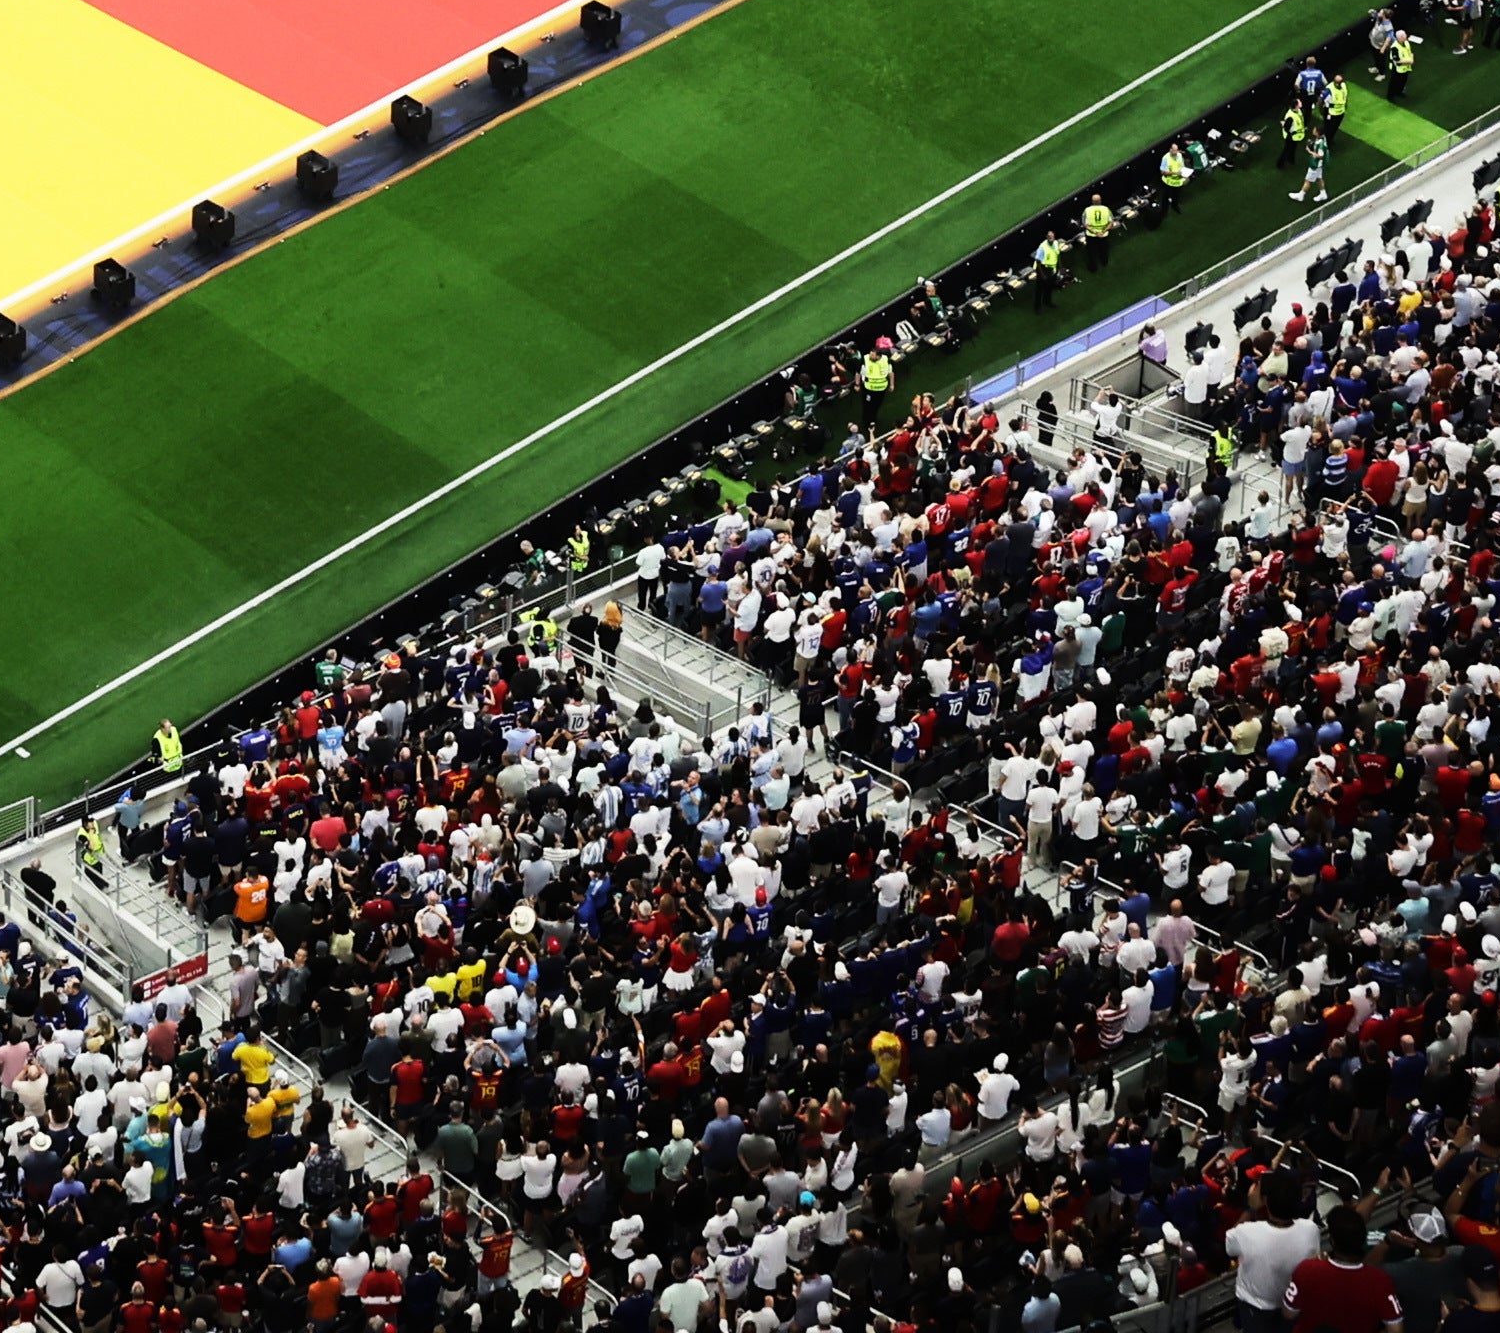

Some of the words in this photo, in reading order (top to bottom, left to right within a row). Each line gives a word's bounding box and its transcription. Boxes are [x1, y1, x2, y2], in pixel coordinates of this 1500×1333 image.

[977, 693, 990, 706] 10
[949, 702, 962, 716] 10
[572, 716, 583, 729] 10
[625, 1085, 639, 1100] 10
